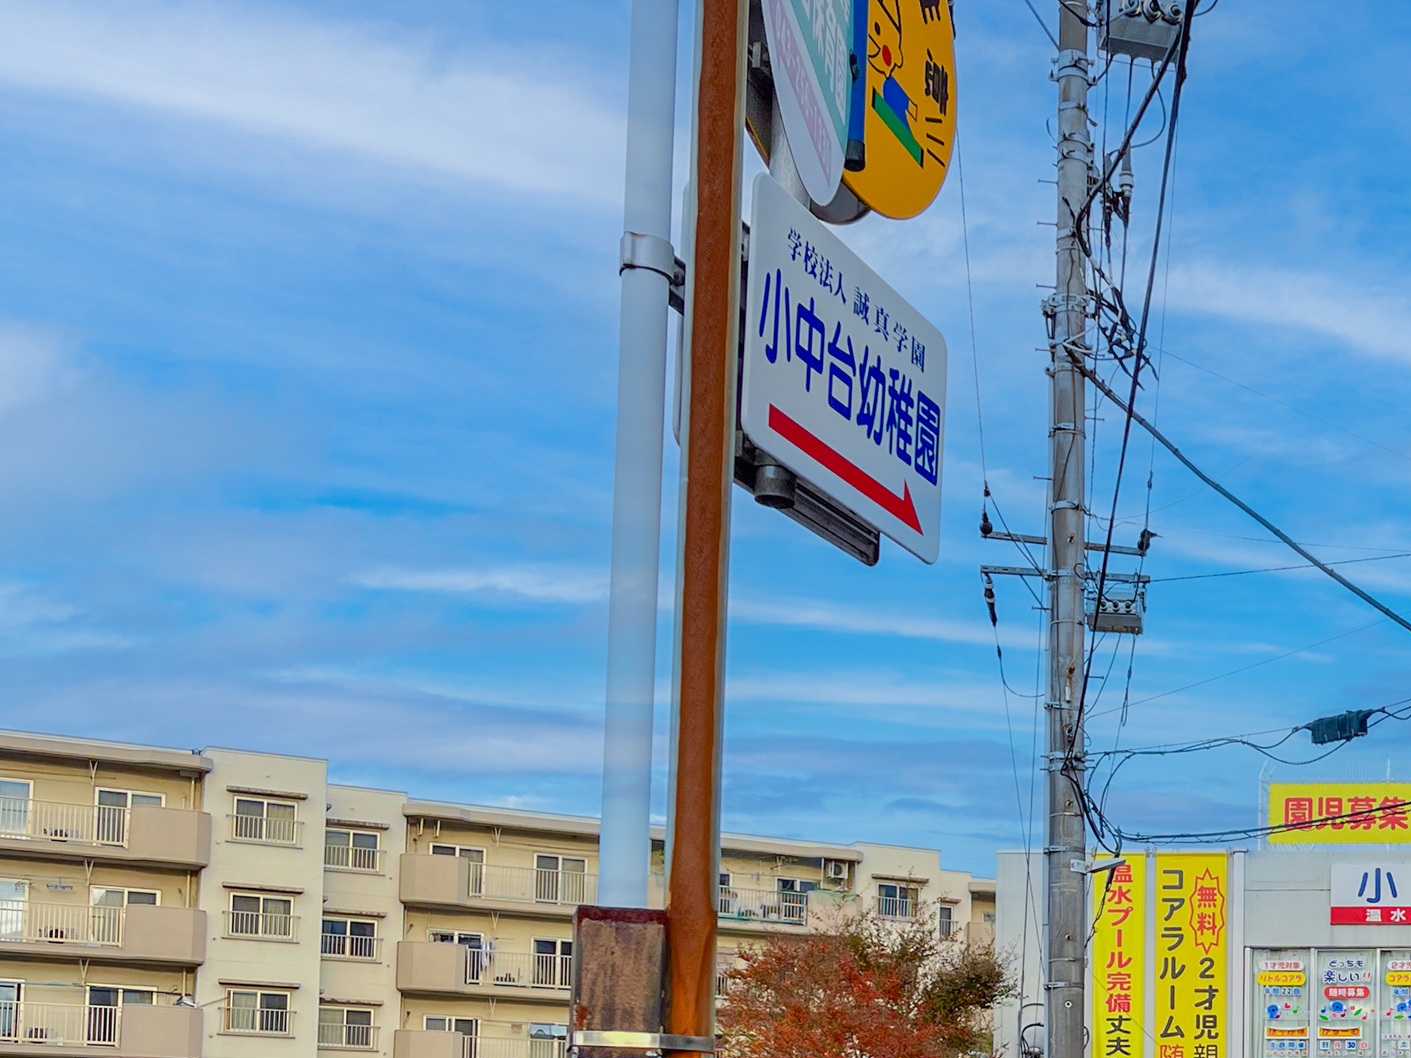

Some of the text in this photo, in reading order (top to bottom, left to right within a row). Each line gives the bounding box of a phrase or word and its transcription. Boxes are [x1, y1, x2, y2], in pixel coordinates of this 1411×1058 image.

[787, 226, 926, 374] 学校法人 誠真学園
[758, 267, 941, 487] 小中台幼稚園
[1283, 795, 1409, 831] 園児募集
[1196, 885, 1218, 936] 無料
[1328, 959, 1364, 968] どっちも
